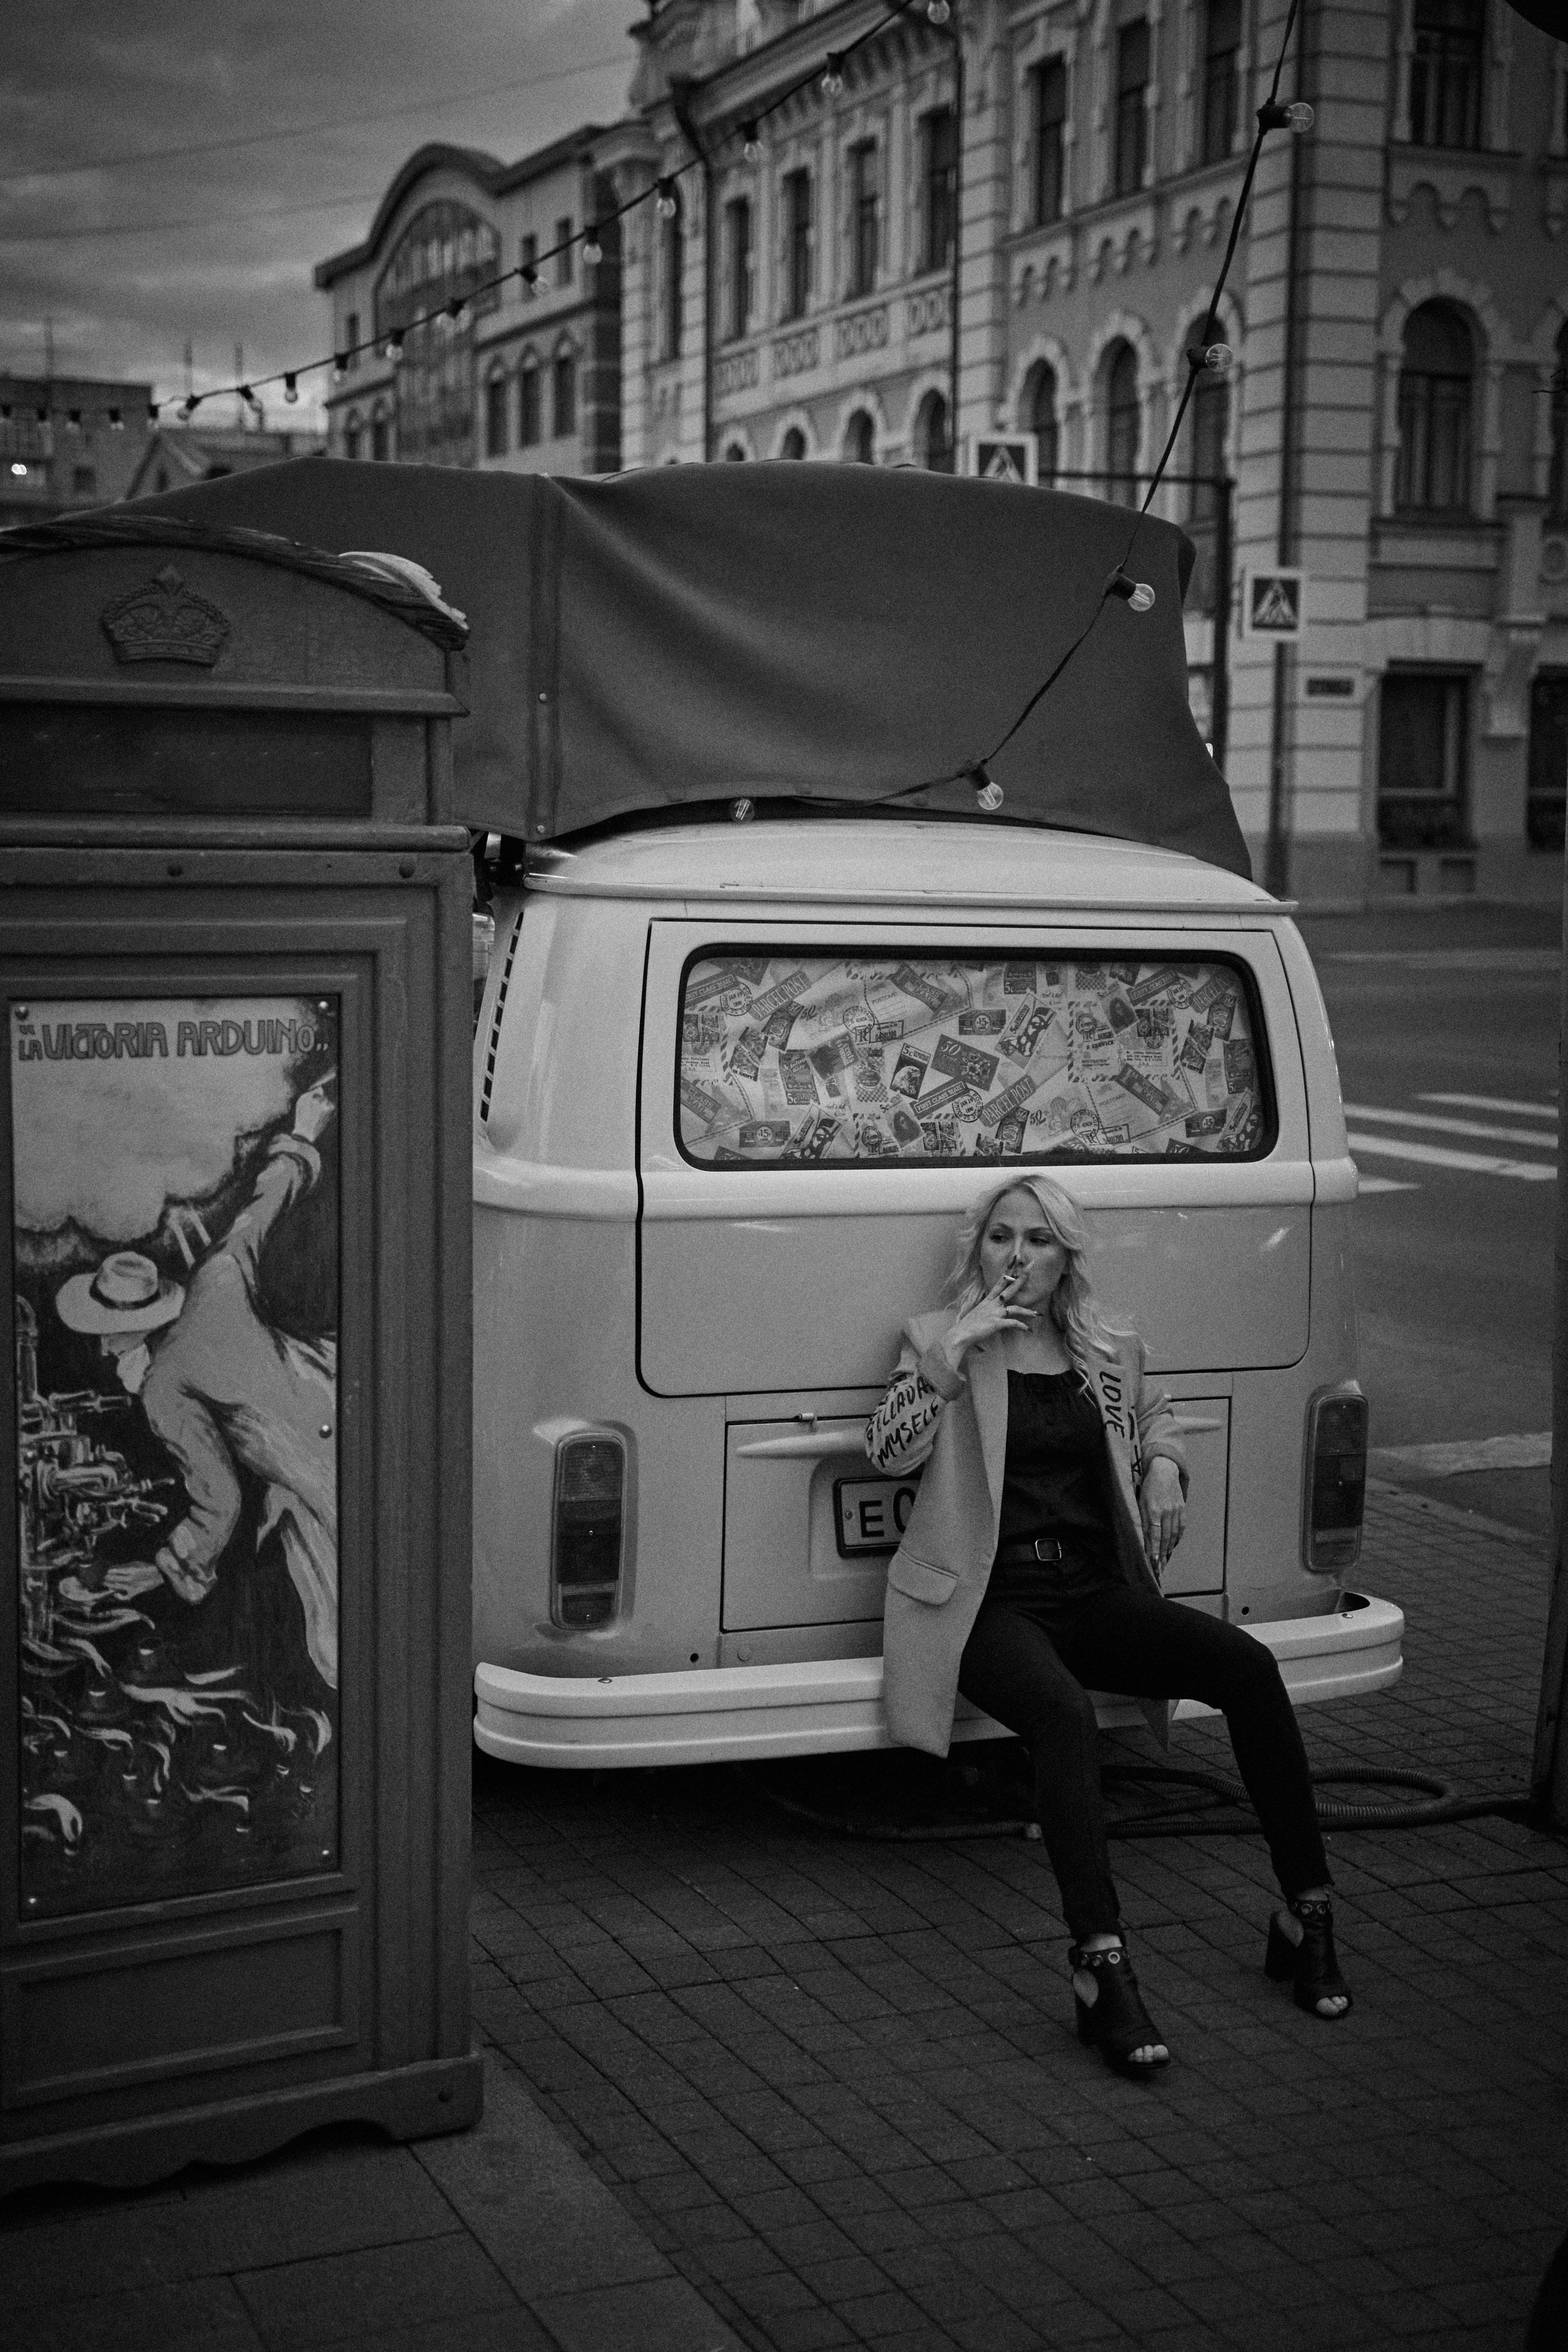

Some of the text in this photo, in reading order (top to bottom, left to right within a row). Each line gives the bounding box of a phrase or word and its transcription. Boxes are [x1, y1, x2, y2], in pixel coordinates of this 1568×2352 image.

[751, 973, 808, 1019] PARCEL POST
[902, 1045, 914, 1057] 5c
[940, 1040, 962, 1056] 50
[918, 1084, 963, 1112] FIRST CLASS MAIL
[982, 1077, 1033, 1125] PARCEL POST
[1099, 1370, 1125, 1439] LOVE
[877, 1395, 940, 1468] MYSELF
